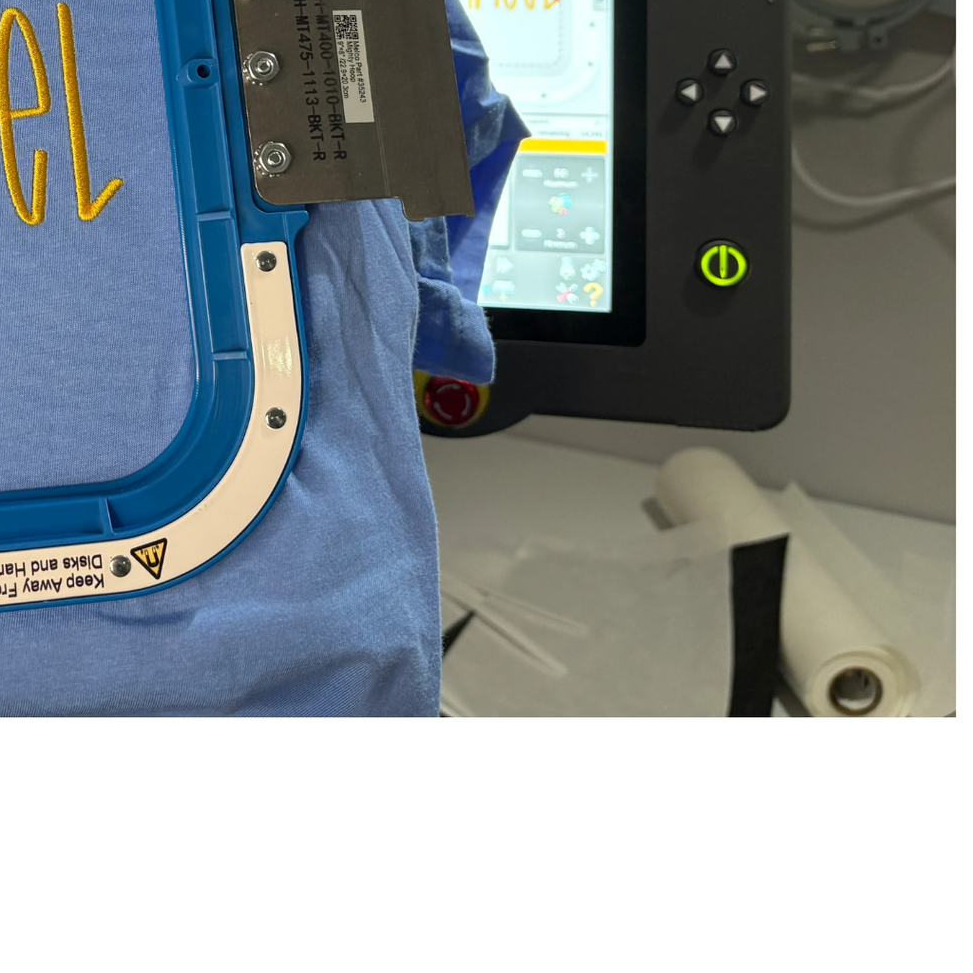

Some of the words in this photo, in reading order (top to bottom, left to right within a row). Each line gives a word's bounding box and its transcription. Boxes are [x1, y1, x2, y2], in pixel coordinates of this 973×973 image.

[345, 40, 355, 64] Mighty
[353, 40, 361, 62] Melco
[357, 77, 367, 104] #35243
[31, 561, 58, 573] and
[63, 553, 103, 571] Disks
[22, 577, 63, 593] Away
[66, 573, 105, 588] Keep
